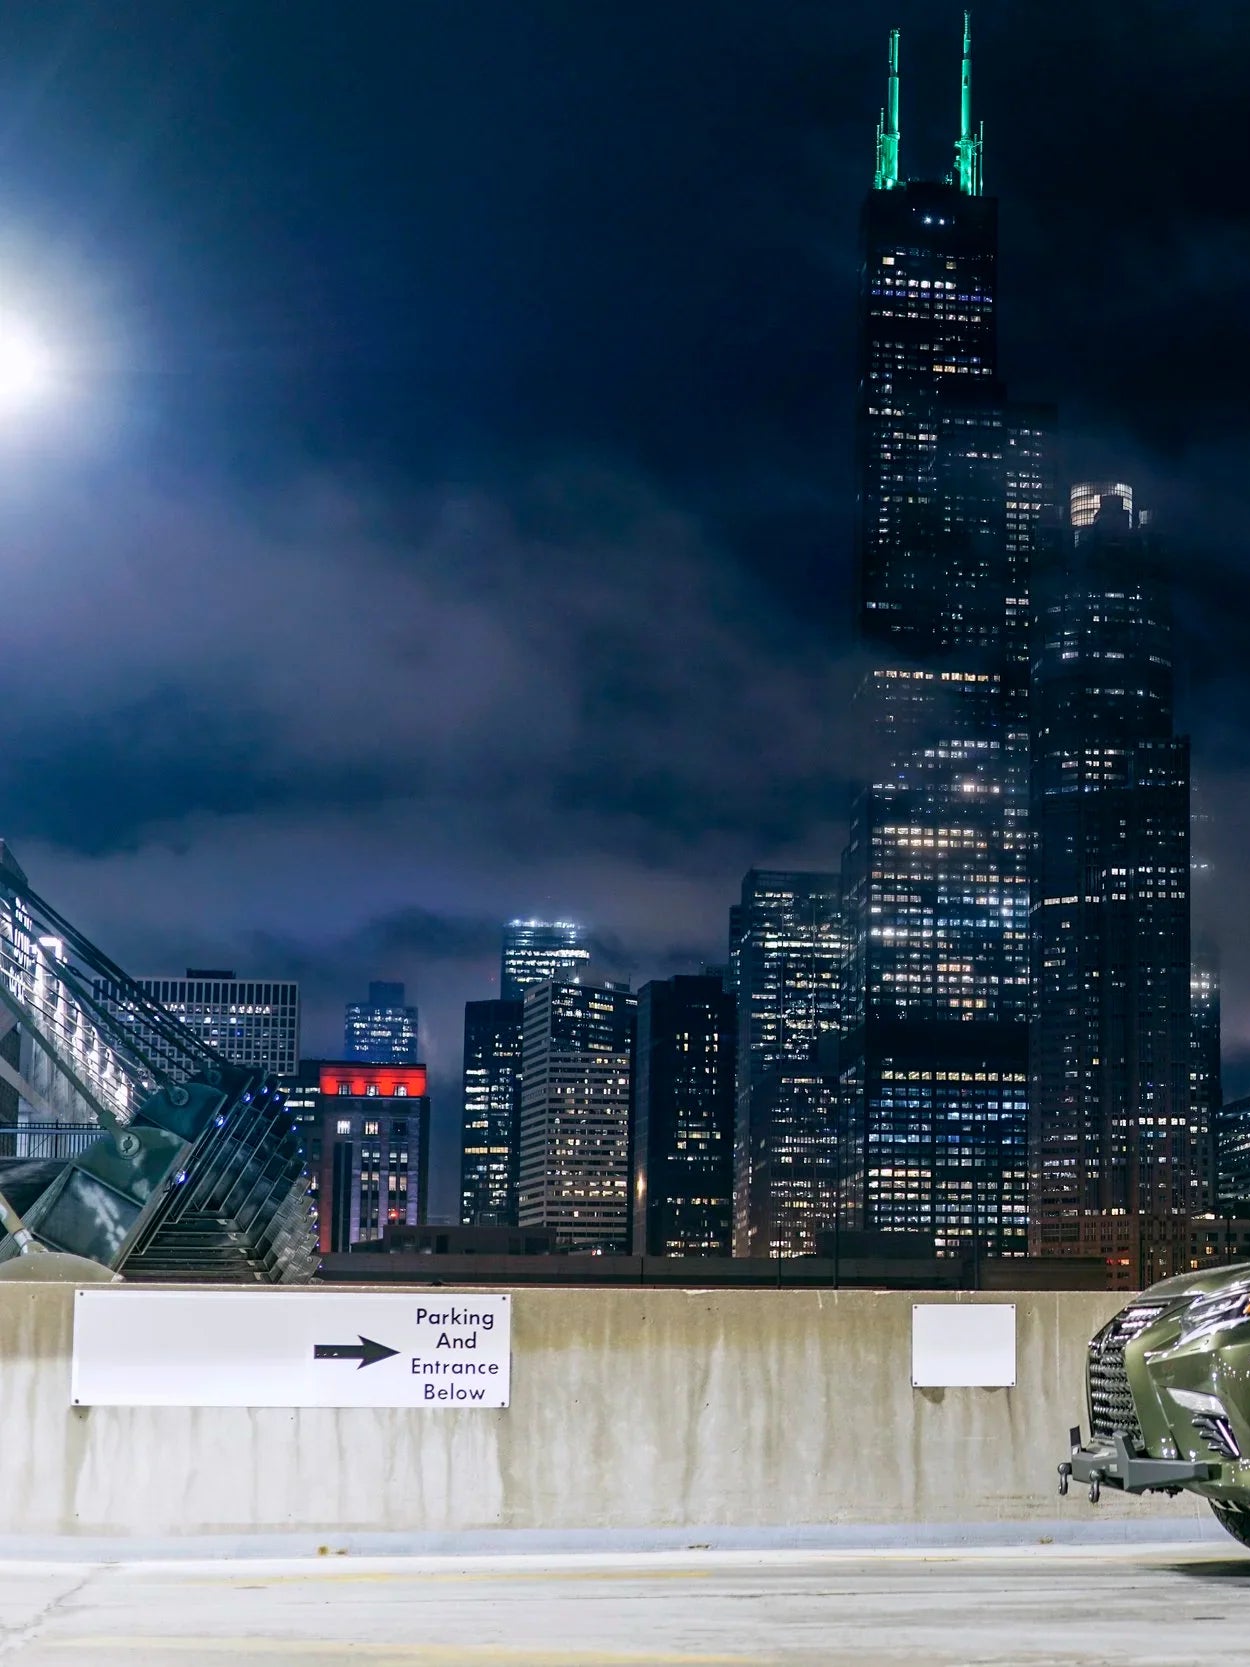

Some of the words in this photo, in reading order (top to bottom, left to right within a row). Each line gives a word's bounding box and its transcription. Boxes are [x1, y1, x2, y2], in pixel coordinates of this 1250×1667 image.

[416, 1307, 494, 1330] Parking
[436, 1331, 477, 1349] And
[411, 1357, 499, 1375] Entrance
[424, 1382, 486, 1400] Below
